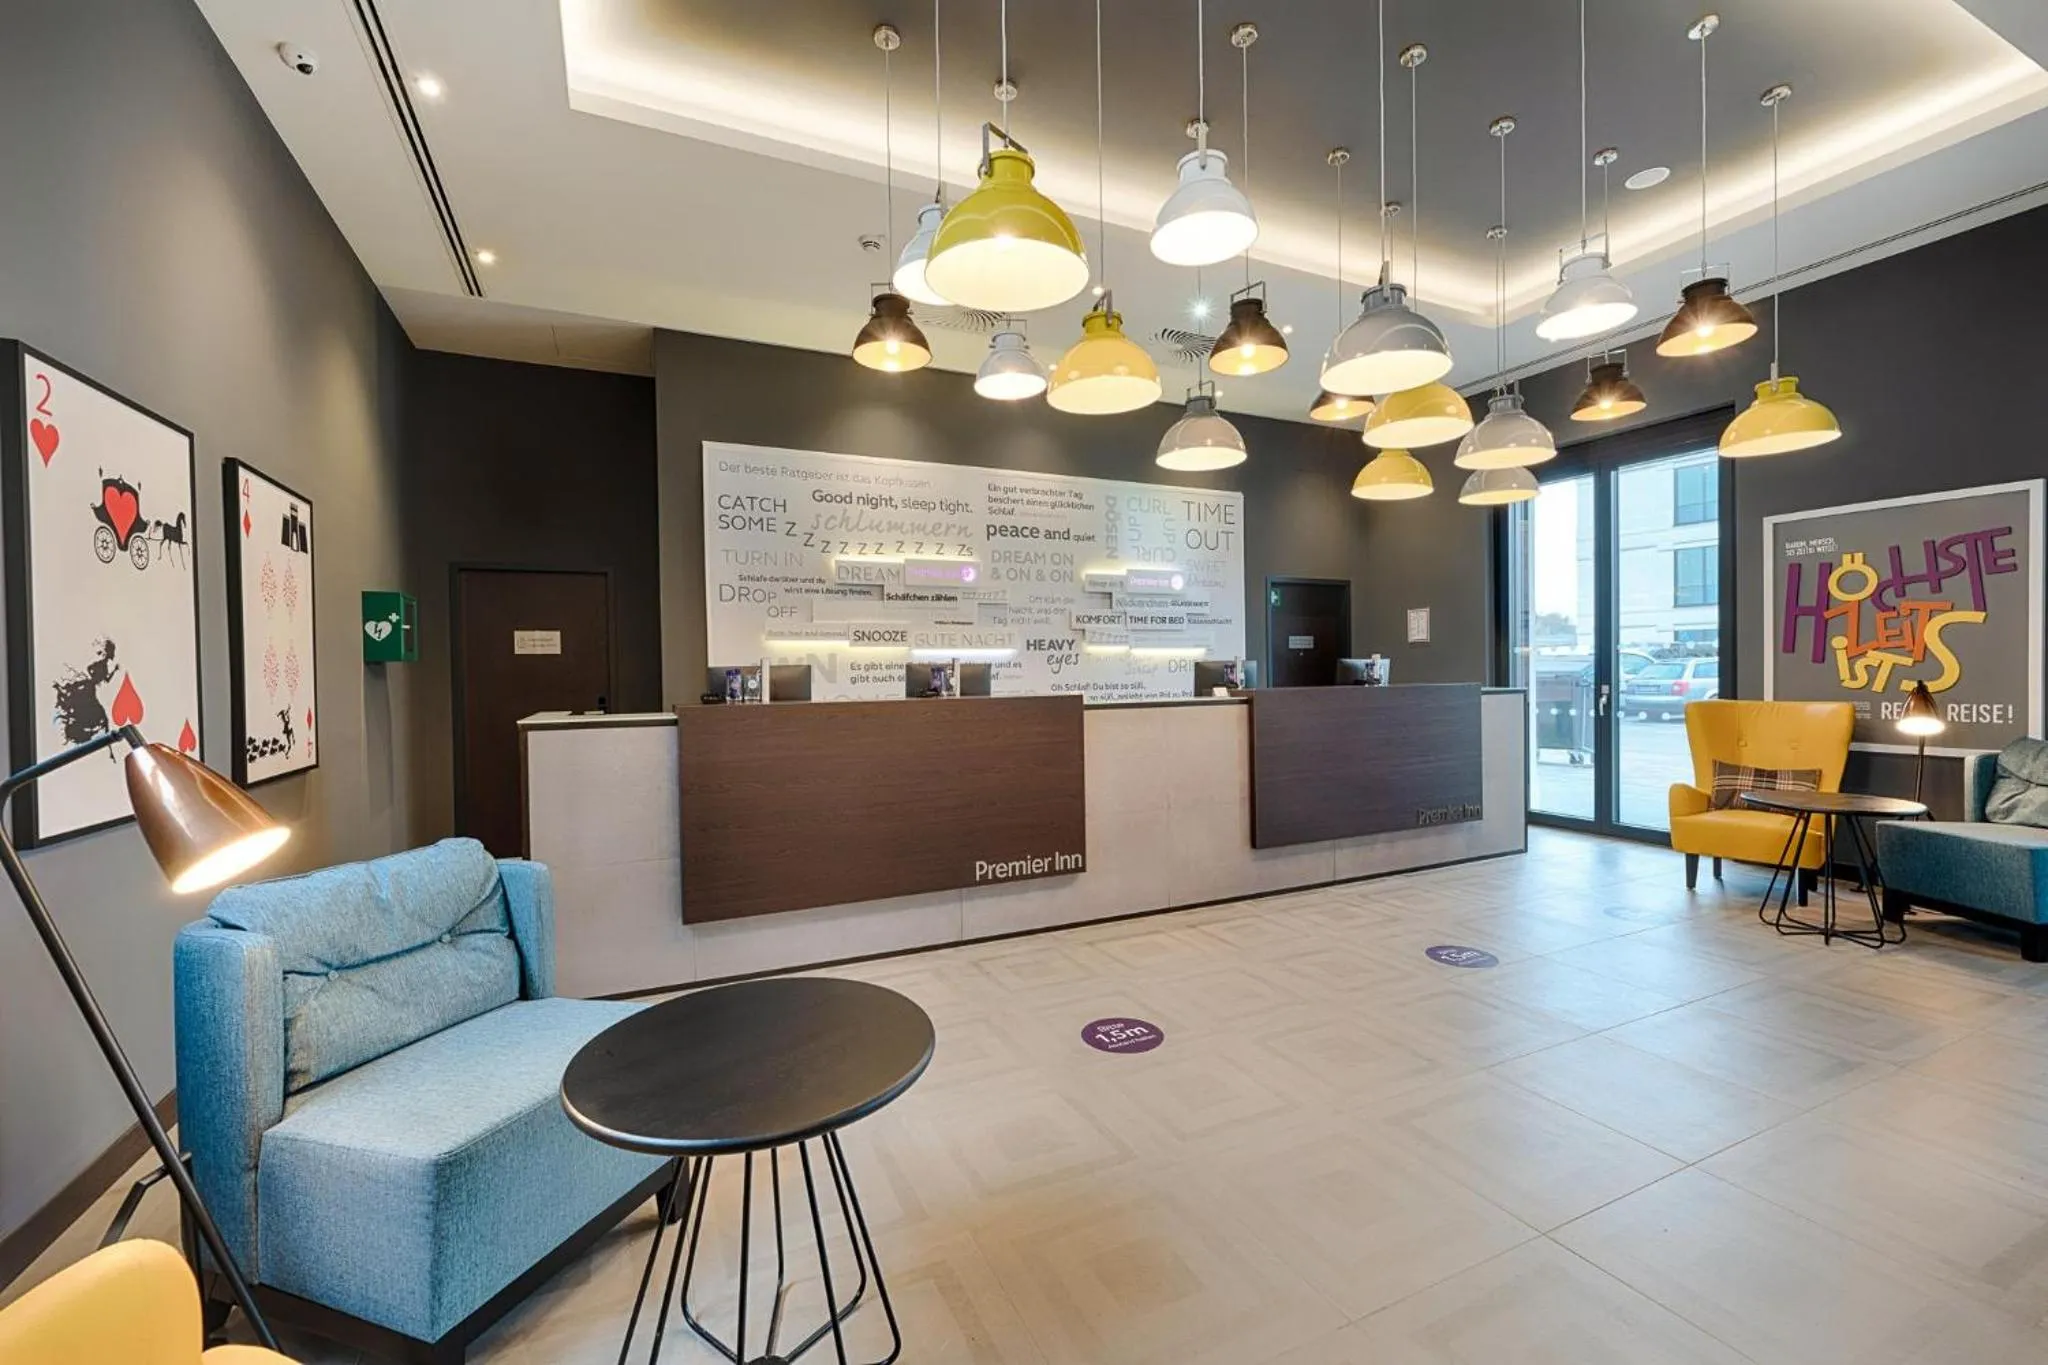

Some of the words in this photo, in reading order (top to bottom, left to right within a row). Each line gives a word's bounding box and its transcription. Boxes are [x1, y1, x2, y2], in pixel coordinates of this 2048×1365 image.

[36, 373, 53, 417] 2
[718, 460, 742, 472] Der
[744, 462, 778, 476] beste
[242, 477, 250, 499] 4
[717, 493, 788, 514] CATCH
[811, 489, 853, 505] Good
[856, 492, 898, 511] night,
[901, 497, 937, 513] sleep
[940, 498, 973, 516] tight.
[1181, 500, 1236, 525] TIME
[717, 513, 777, 533] SOME
[810, 506, 974, 538] schlummern
[1104, 495, 1119, 560] DÖSEN
[985, 523, 1041, 541] peace
[1043, 528, 1071, 541] and
[1072, 532, 1096, 543] quiet
[1185, 528, 1236, 552] OUT
[720, 549, 779, 567] TURN
[783, 551, 804, 568] IN
[991, 549, 1046, 566] DREAM
[1050, 552, 1074, 567] ON
[836, 563, 901, 583] DREAM
[1006, 567, 1031, 581] ON
[1049, 569, 1074, 583] ON
[718, 583, 777, 604] DROP
[885, 591, 929, 602] Schäfchen
[930, 592, 958, 603] zählen
[1783, 526, 2017, 664] HÖCHSTE
[766, 604, 799, 618] OFF
[1075, 614, 1122, 625] KOMFORT
[1128, 615, 1149, 626] TIME
[1150, 615, 1167, 626] FOR
[1169, 616, 1185, 626] BED
[852, 629, 908, 643] SNOOZE
[914, 632, 958, 648] GUTE
[962, 633, 1016, 649] NACHT
[1025, 637, 1076, 652] HEAVY
[850, 662, 862, 672] Es
[864, 660, 883, 673] gibt
[1046, 651, 1080, 675] eyes
[850, 673, 870, 685] gibt
[872, 672, 895, 684] auch
[1946, 703, 2014, 724] REISE!
[975, 854, 1052, 882] Premier
[1055, 850, 1083, 872] Inn
[1094, 1026, 1149, 1043] 1,5m
